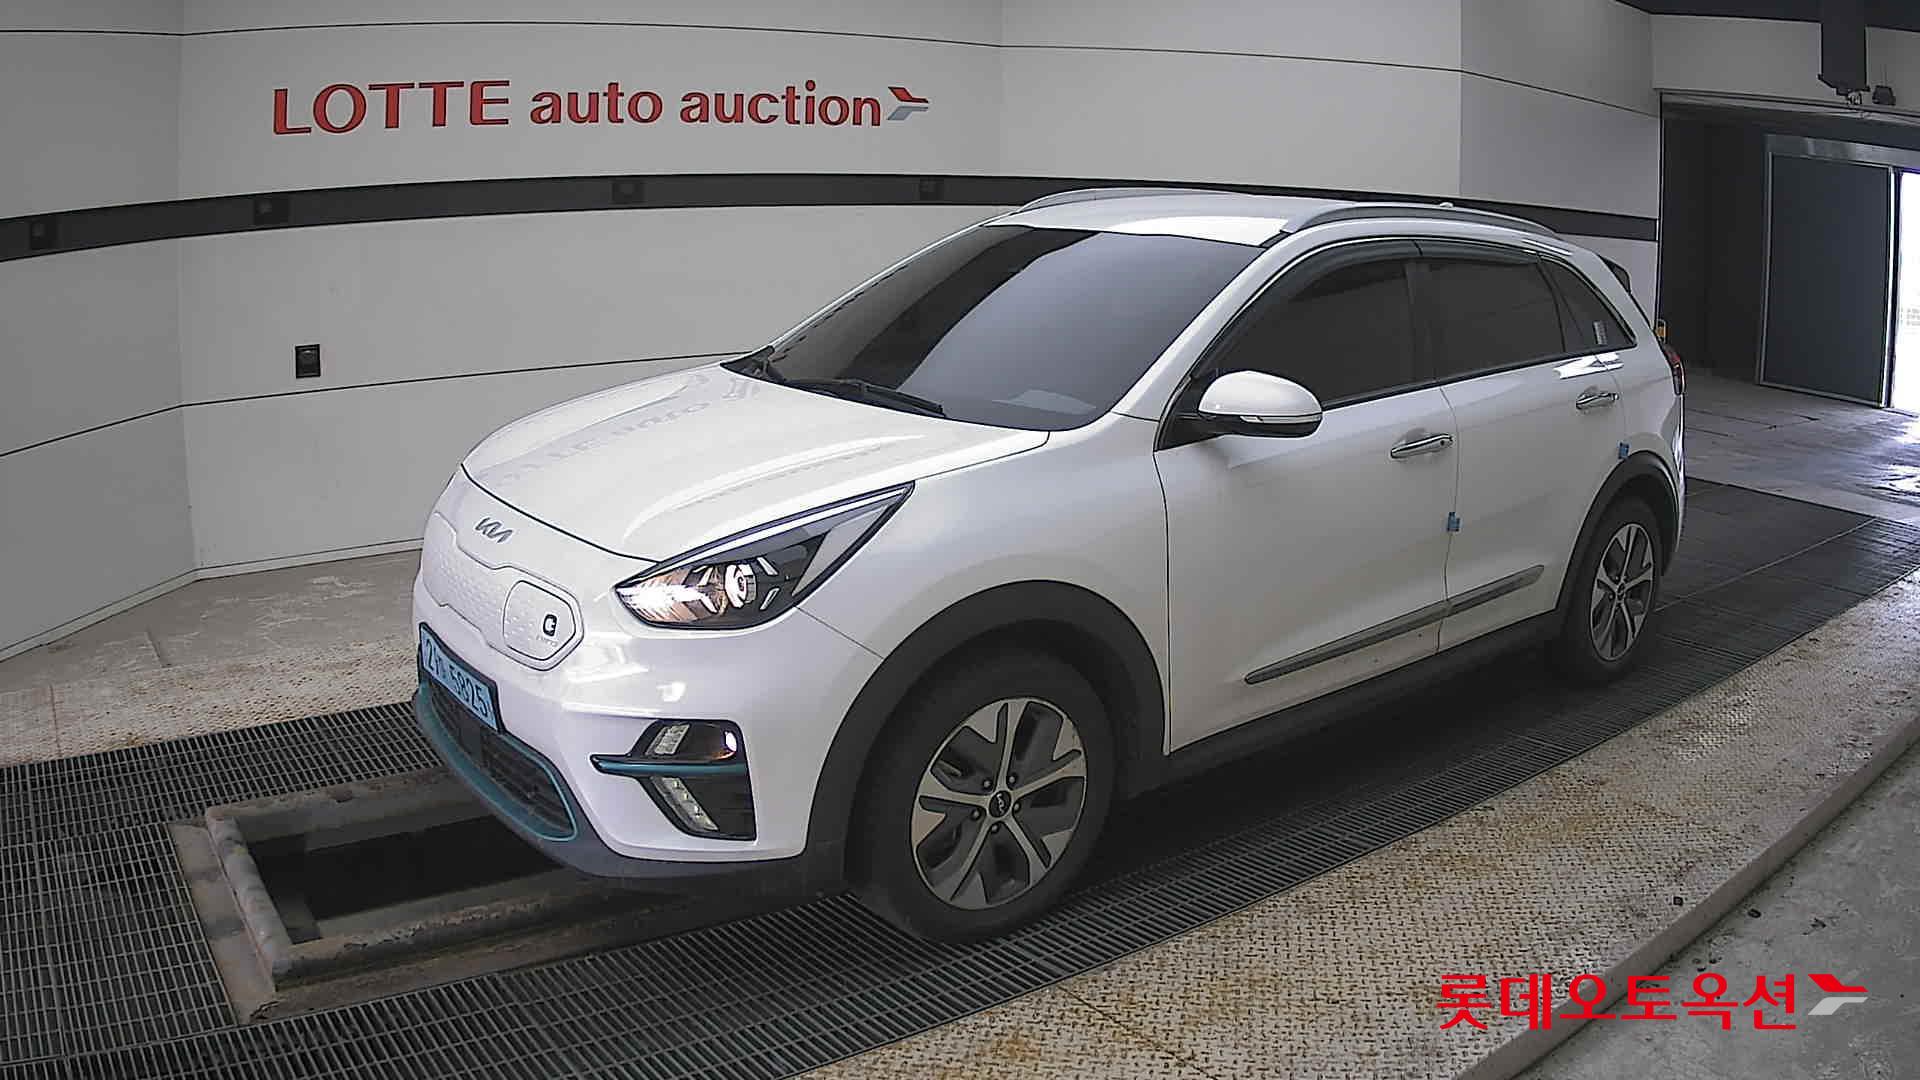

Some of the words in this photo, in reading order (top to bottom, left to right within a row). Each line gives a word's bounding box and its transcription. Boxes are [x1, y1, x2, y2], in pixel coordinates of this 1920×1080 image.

[273, 79, 510, 135] LOTTE
[530, 81, 663, 125] auto
[680, 80, 882, 126] auction
